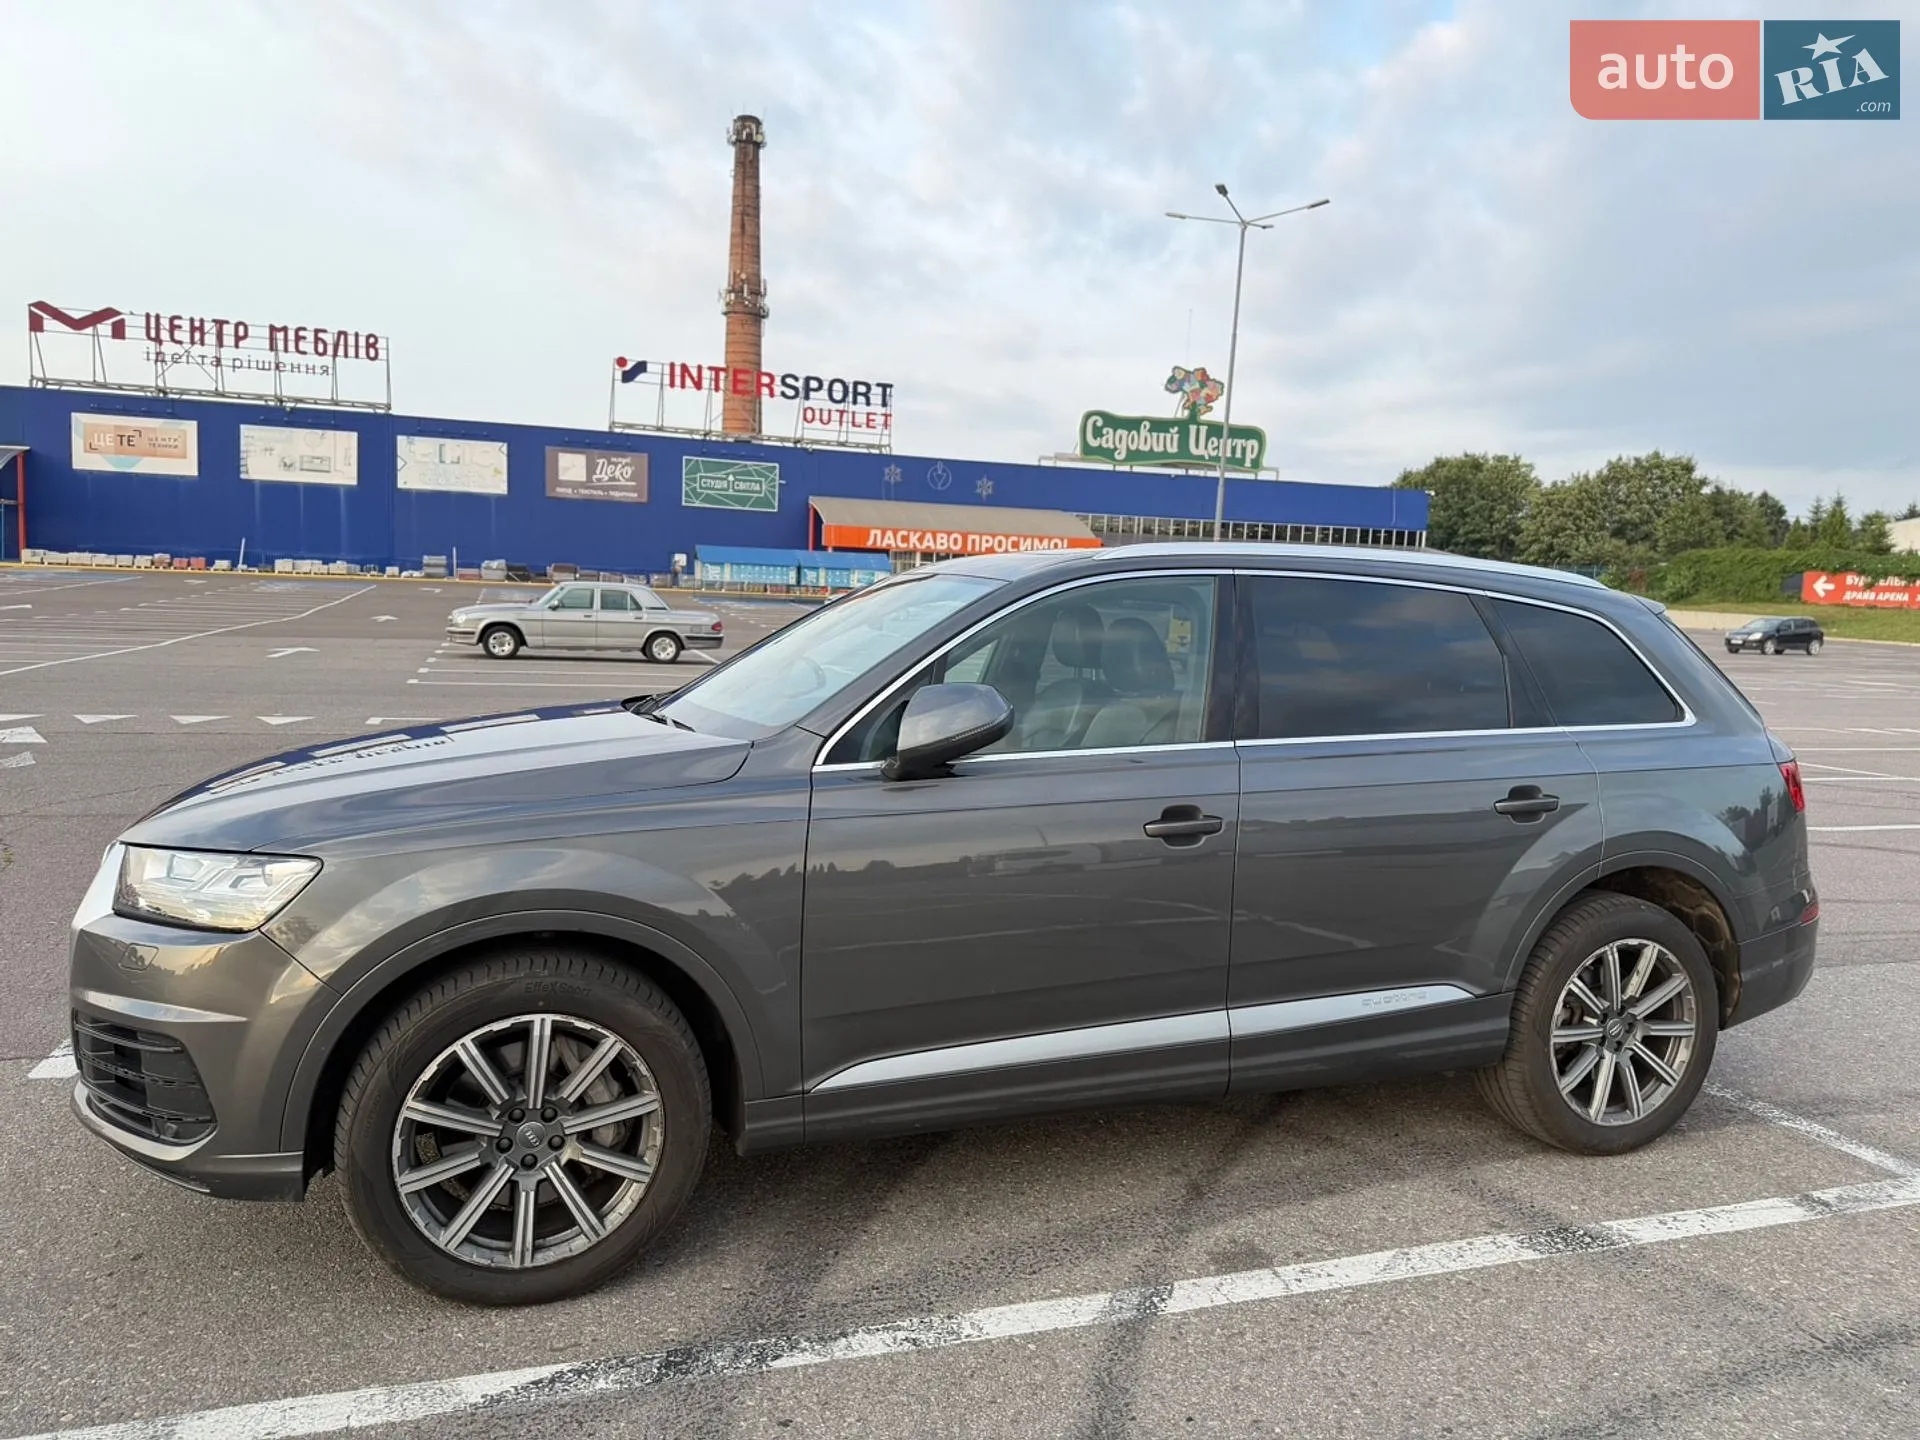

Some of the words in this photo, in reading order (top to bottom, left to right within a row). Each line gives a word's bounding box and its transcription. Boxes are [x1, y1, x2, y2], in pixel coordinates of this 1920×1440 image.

[145, 312, 249, 349] ЦЕНТР
[269, 323, 379, 361] МЕБЛІВ
[232, 354, 330, 376] рішення
[669, 361, 893, 408] INTERSPORT
[802, 406, 892, 430] OUTLET
[1085, 415, 1180, 461] Садовий
[867, 528, 962, 550] ЛАСКАВО
[967, 534, 1068, 553] ПРОСИМО!
[1878, 591, 1909, 601] АРЕНА
